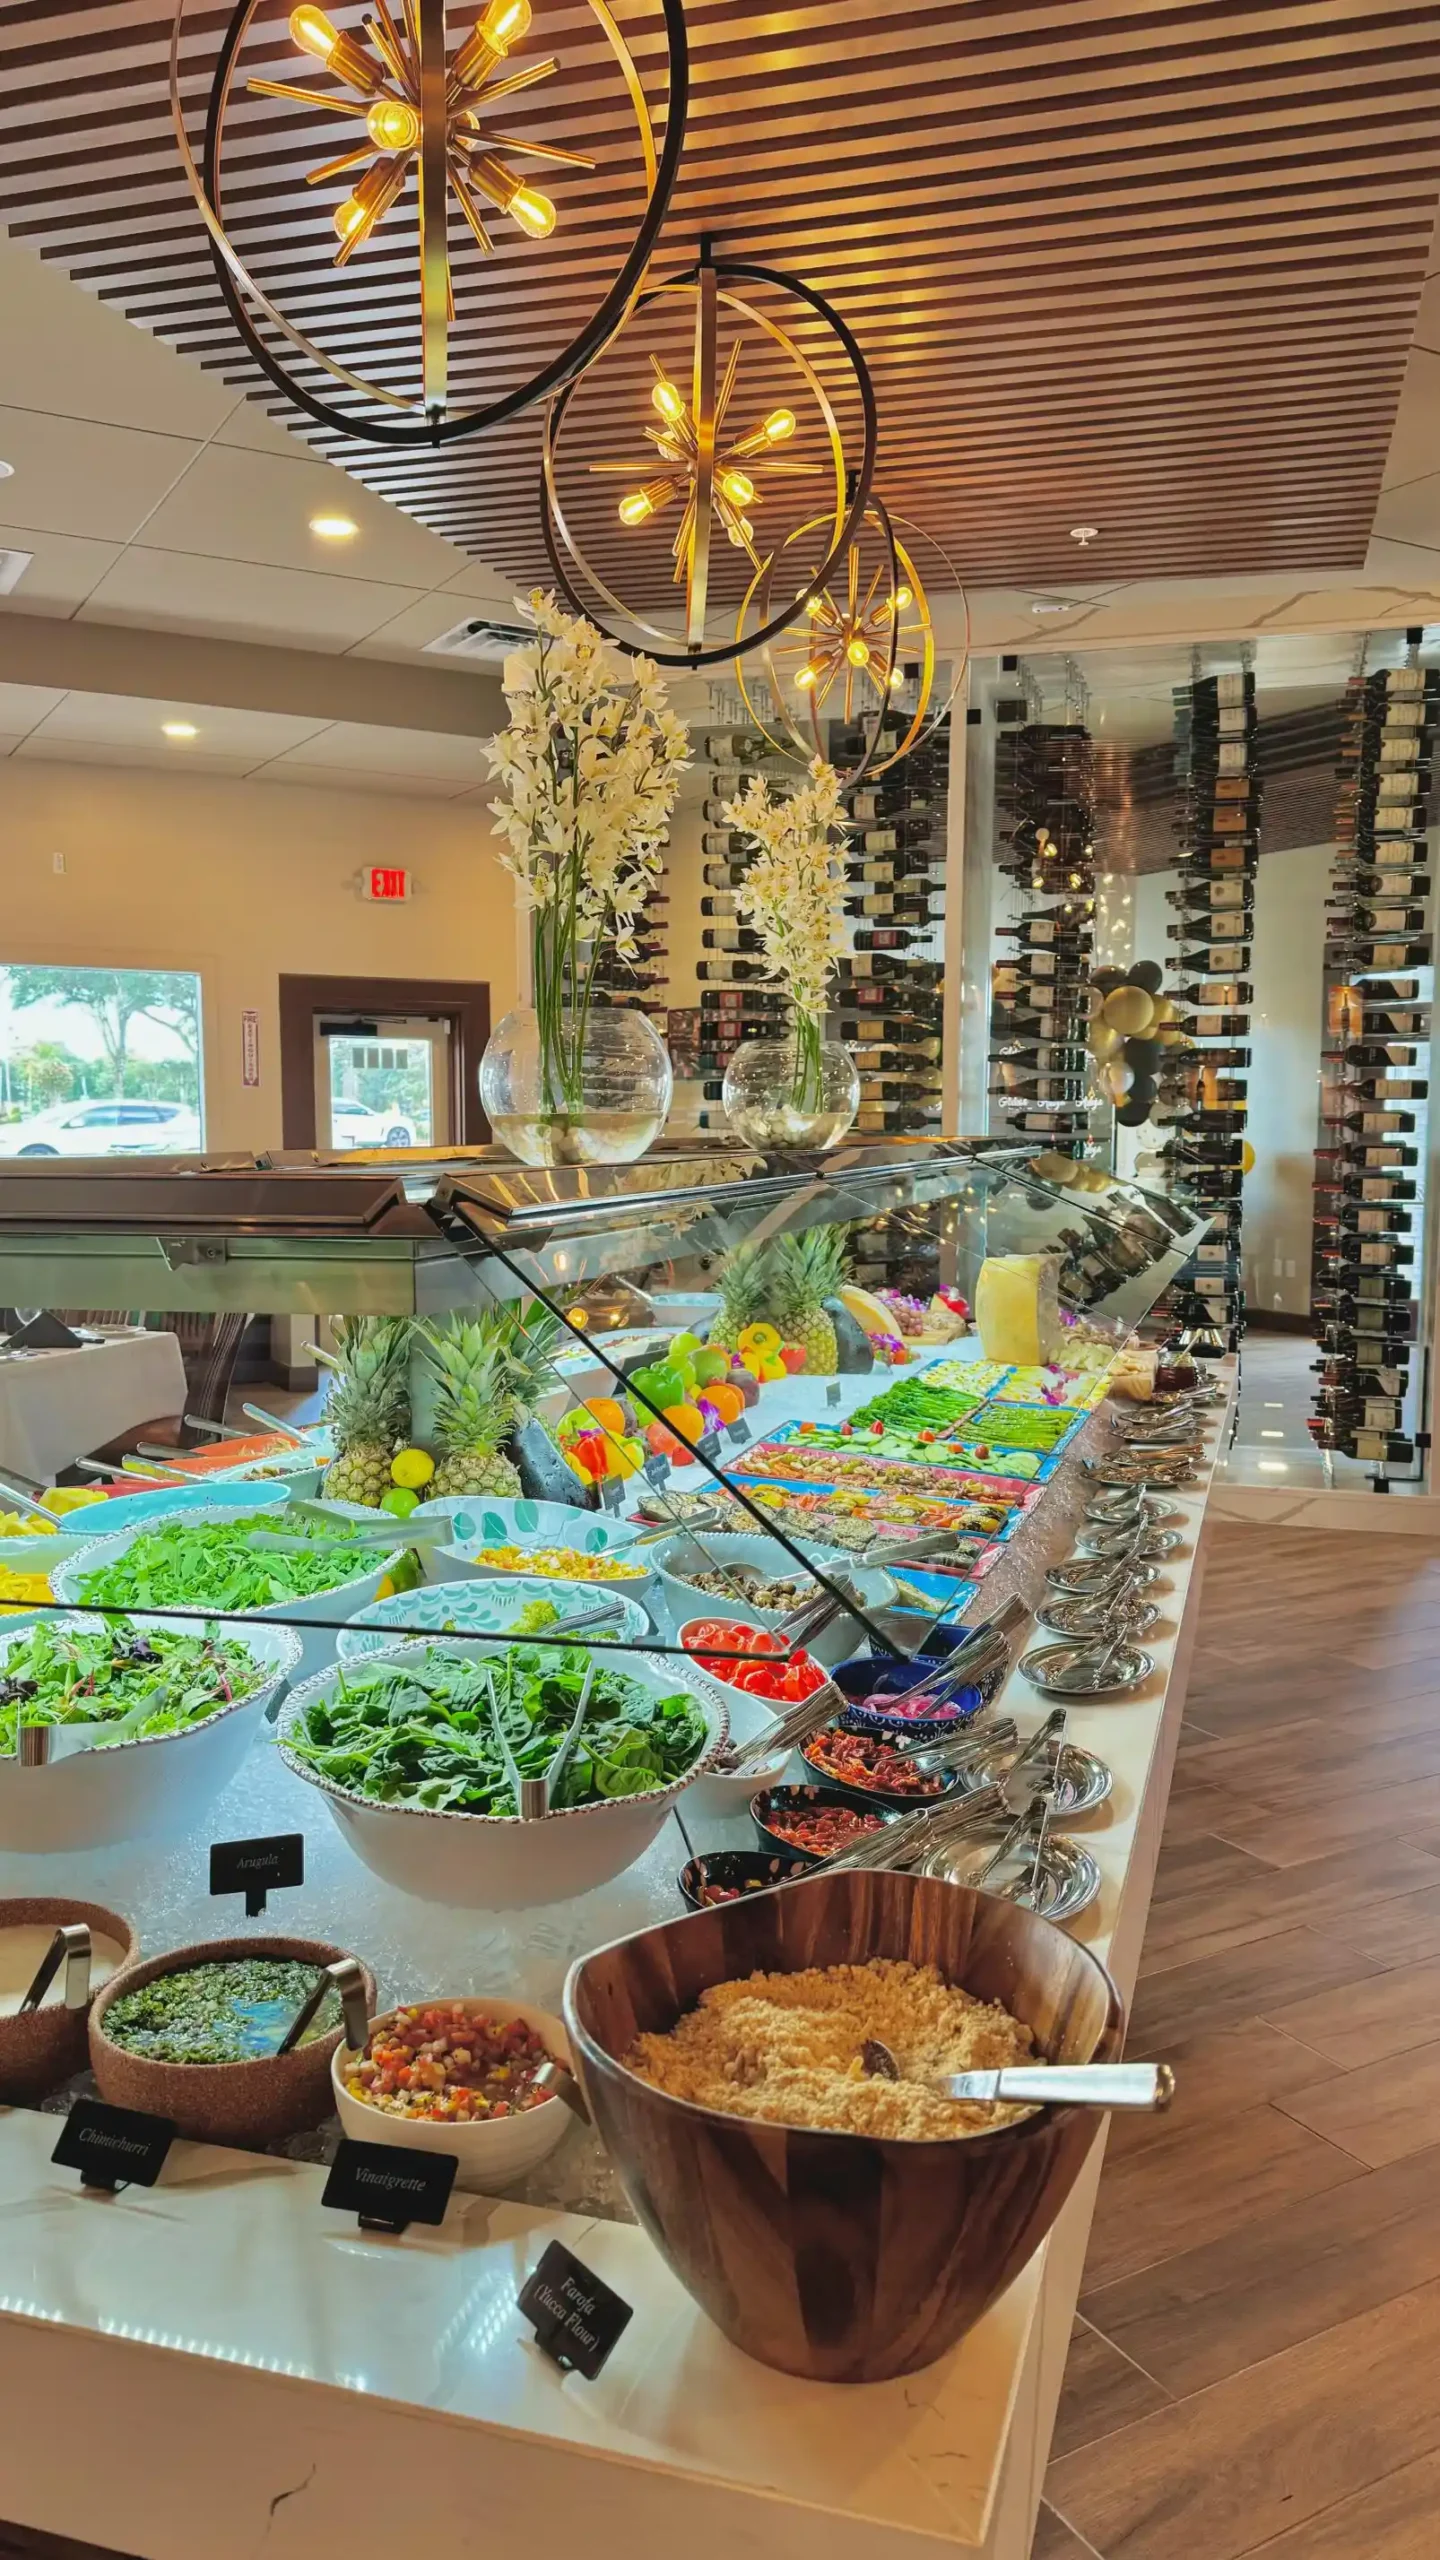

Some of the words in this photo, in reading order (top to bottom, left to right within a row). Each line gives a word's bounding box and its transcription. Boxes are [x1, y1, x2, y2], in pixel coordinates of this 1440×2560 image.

[371, 868, 405, 898] EXIT
[236, 1853, 279, 1870] Arugula
[79, 2128, 152, 2156] Chimichurri
[355, 2167, 427, 2191] Vinaigrette
[560, 2277, 596, 2316] Farofa
[533, 2284, 567, 2320] (Yucca
[564, 2312, 600, 2353] Flour)
